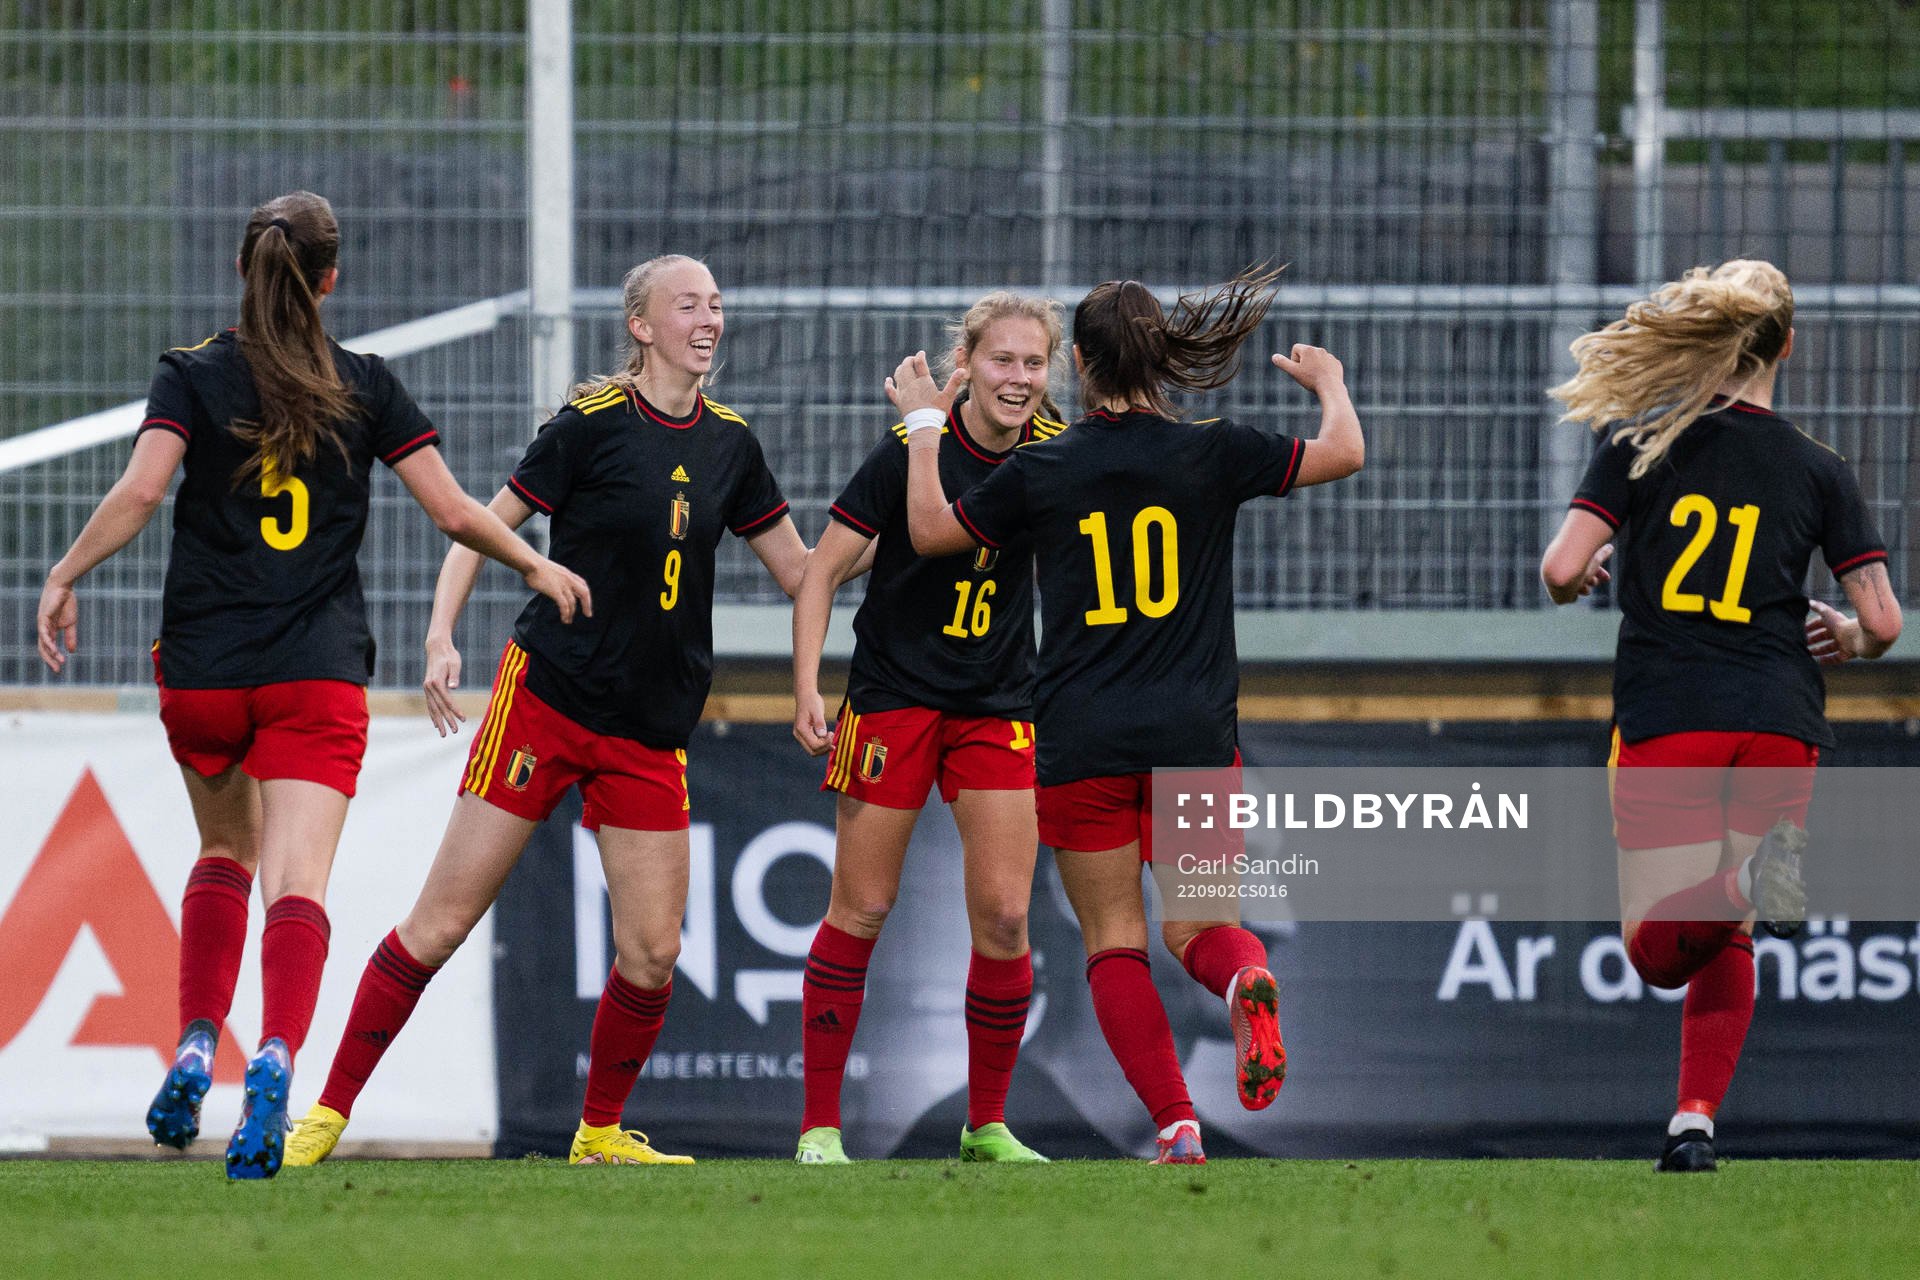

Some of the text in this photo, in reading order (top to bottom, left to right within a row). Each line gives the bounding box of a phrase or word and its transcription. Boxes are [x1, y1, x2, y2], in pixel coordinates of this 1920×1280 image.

[261, 453, 309, 551] 5
[660, 550, 682, 610] 9
[943, 580, 997, 638] 16
[1079, 506, 1179, 626] 10
[1662, 494, 1760, 624] 21
[1437, 894, 1556, 1001] Är
[1753, 914, 1920, 1001] näs
